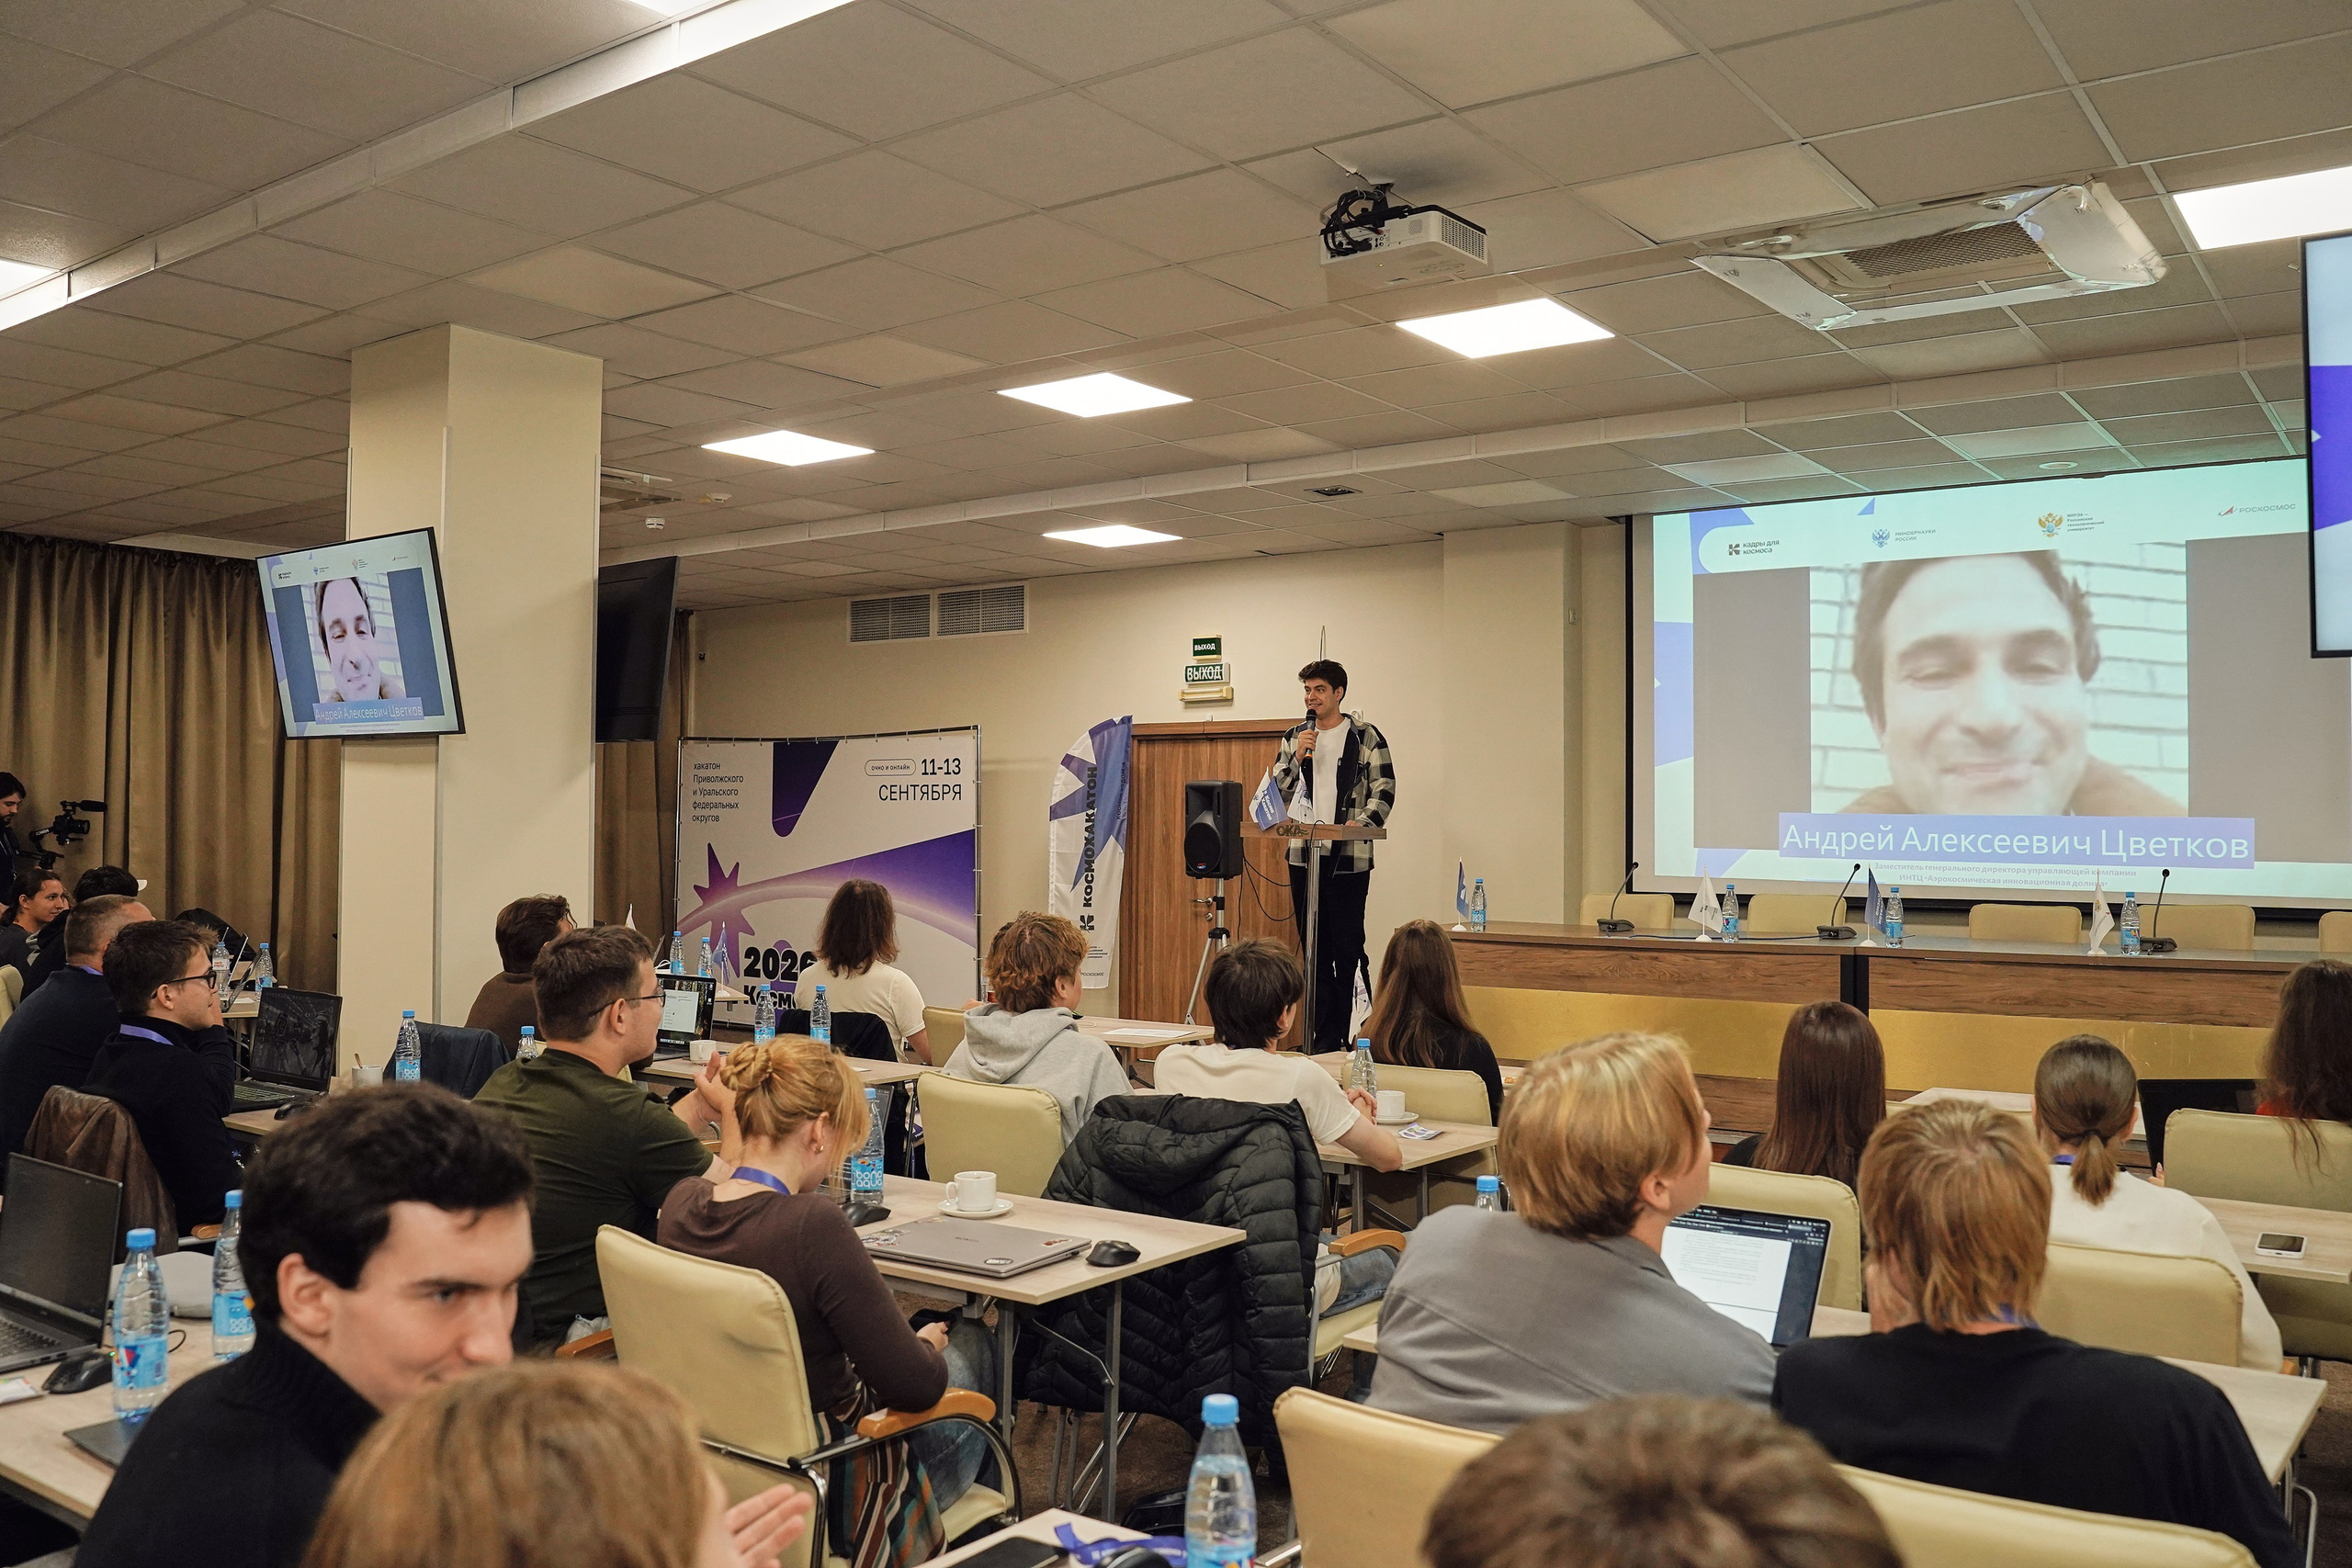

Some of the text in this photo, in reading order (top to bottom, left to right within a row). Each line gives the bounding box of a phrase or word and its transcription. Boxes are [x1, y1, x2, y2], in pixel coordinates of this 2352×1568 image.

[2239, 503, 2296, 513] РОСКОСМОС
[1743, 540, 1766, 548] кадры
[1743, 547, 1773, 555] космоса
[1194, 643, 1216, 651] ВЫХОД
[1187, 666, 1221, 681] ВЫХОД
[315, 705, 423, 723] Андрей Алексеевич Цветков
[922, 758, 961, 775] 11-13
[693, 774, 744, 784] Приволжского
[699, 787, 739, 797] Уральского
[878, 784, 961, 801] СЕНТЯБРЯ
[692, 801, 740, 810] федеральных
[692, 815, 720, 824] округов
[1082, 766, 1097, 908] КОСМОХАКАТОН
[1782, 824, 2249, 863] Андрей Алексеевич Цветков
[1899, 874, 1924, 883] ИНТЦ
[2002, 878, 2071, 886] инновационная
[743, 946, 818, 982] 2026
